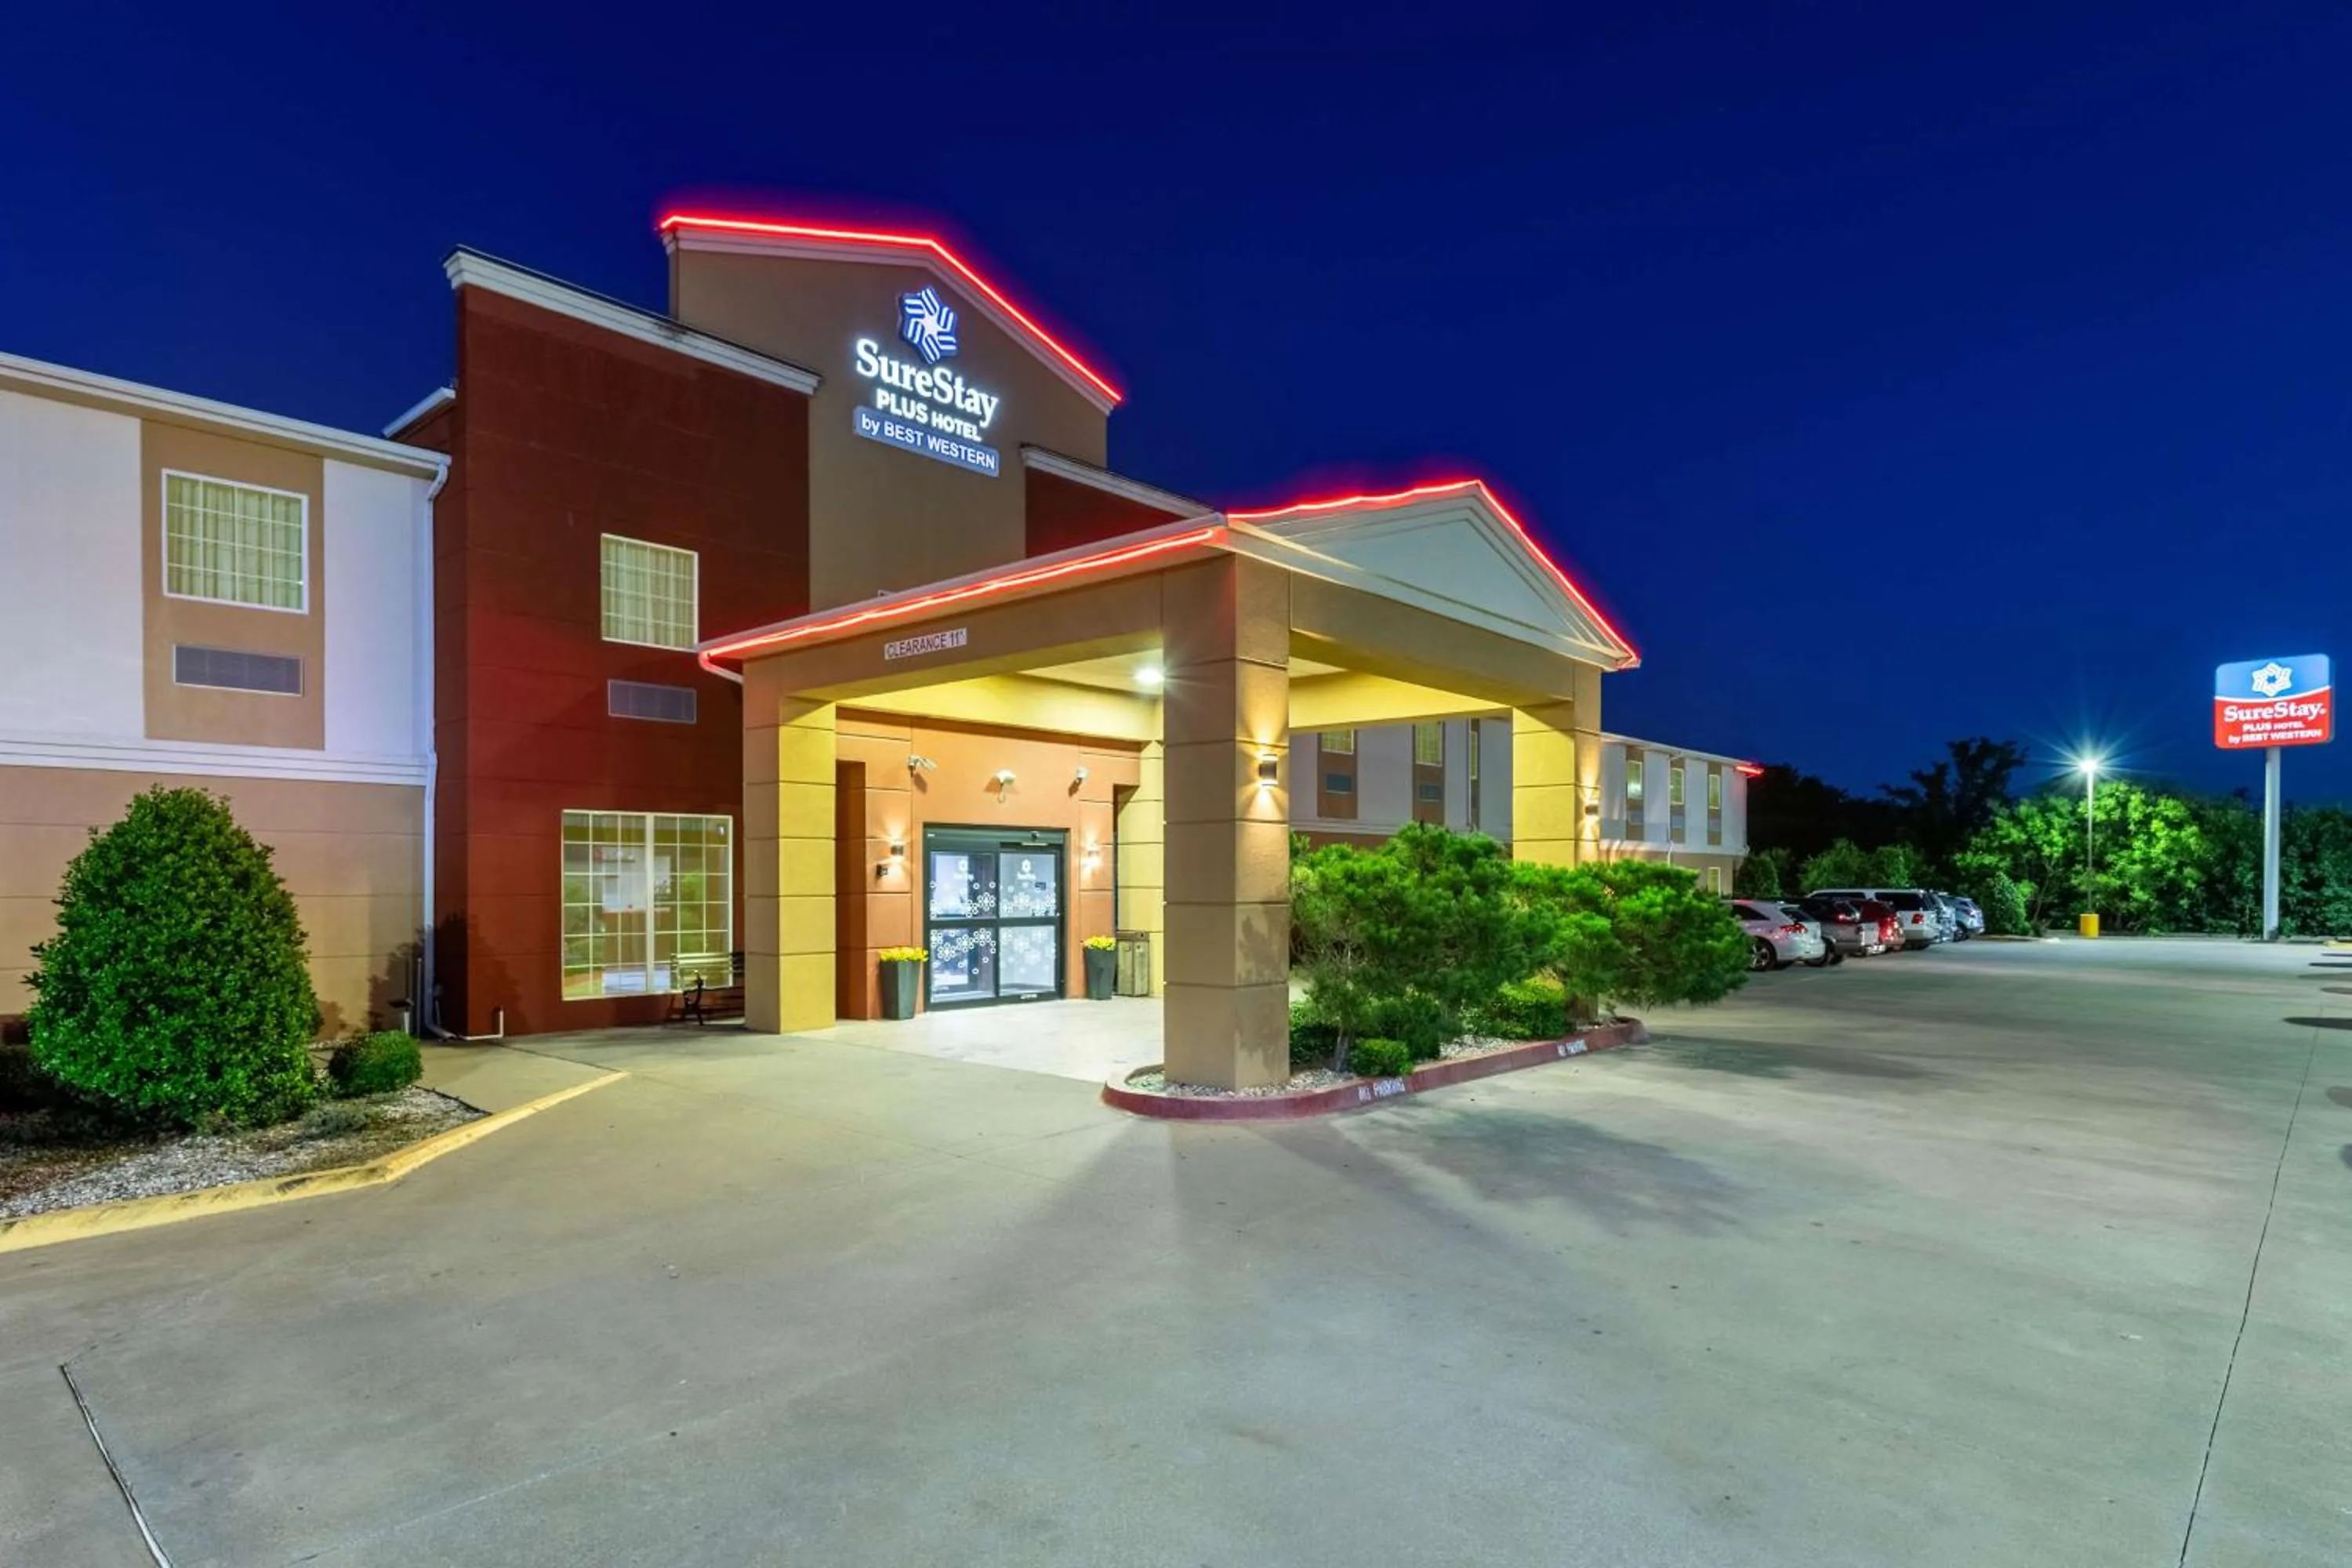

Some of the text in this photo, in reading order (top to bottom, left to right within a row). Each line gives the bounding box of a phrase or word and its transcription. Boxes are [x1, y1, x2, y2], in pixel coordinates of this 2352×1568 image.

[856, 338, 999, 427] SureStay
[877, 389, 982, 441] PLUS HOTEL
[862, 413, 996, 470] by BEST WESTERN
[887, 634, 946, 657] CLEARANCE
[2223, 702, 2323, 722] SureStay
[2228, 728, 2322, 744] by BEST WESTERN
[2242, 720, 2305, 731] PLUS HOTEL
